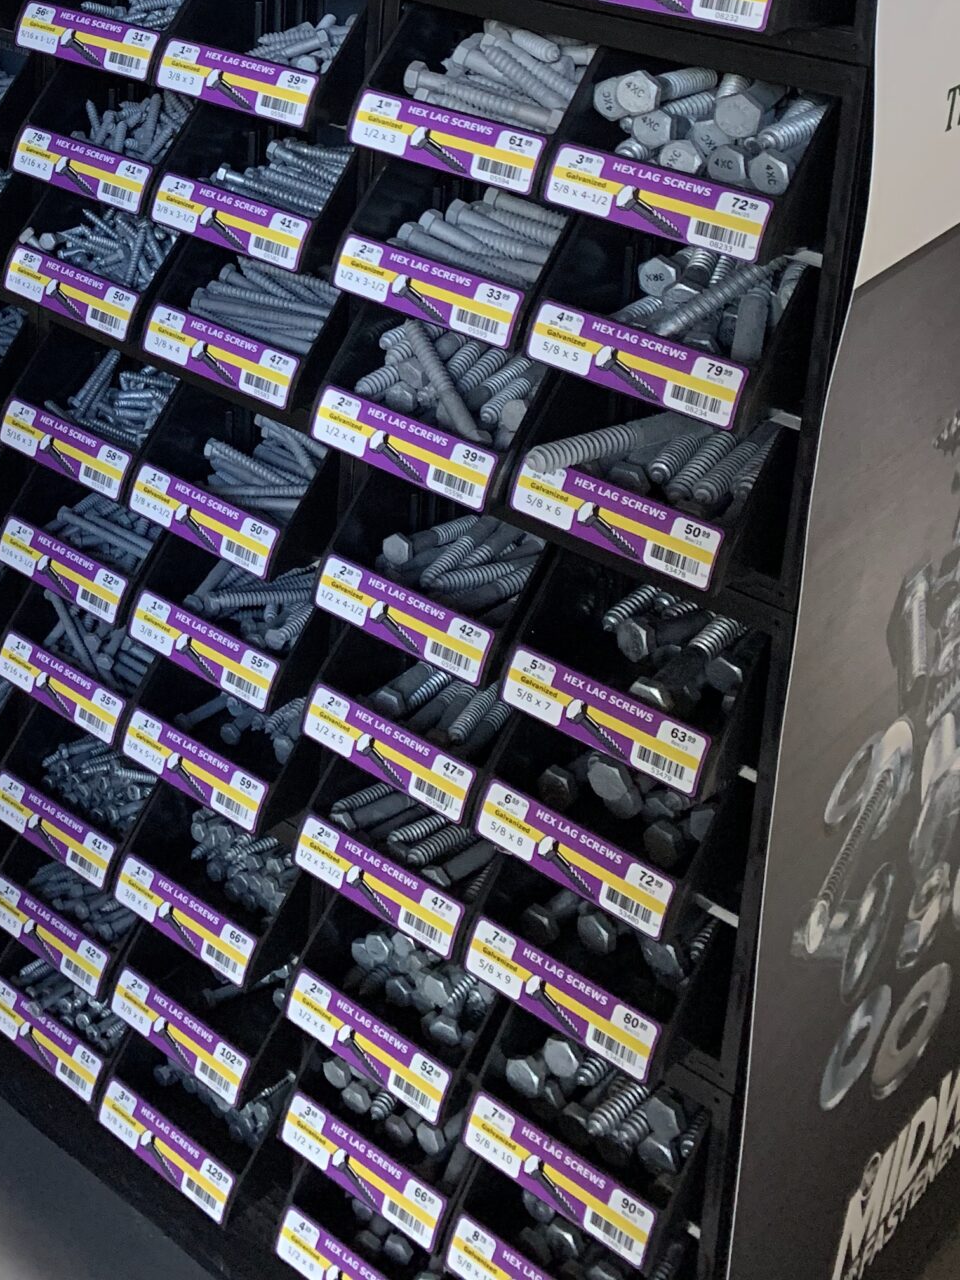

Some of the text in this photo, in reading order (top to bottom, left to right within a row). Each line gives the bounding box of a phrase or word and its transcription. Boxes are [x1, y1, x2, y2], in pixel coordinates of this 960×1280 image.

[553, 183, 569, 195] 5/8
[566, 172, 606, 189] Galvanized
[612, 163, 712, 196] HEX LAG SCREWS
[191, 320, 258, 353] HEX LAG SCREWS
[547, 328, 587, 347] Galvanized
[592, 322, 688, 361] HEX LAG SCREWS
[525, 494, 543, 508] 5/8
[530, 482, 569, 503] Galvanized
[574, 477, 667, 521] HEX LAG SCREWS
[520, 676, 558, 698] Galvanized
[563, 673, 654, 723] HEX LAG SCREWS
[140, 1106, 200, 1159] HEX LAG SCREWS
[521, 1126, 607, 1190] HEX LAG SCREWS
